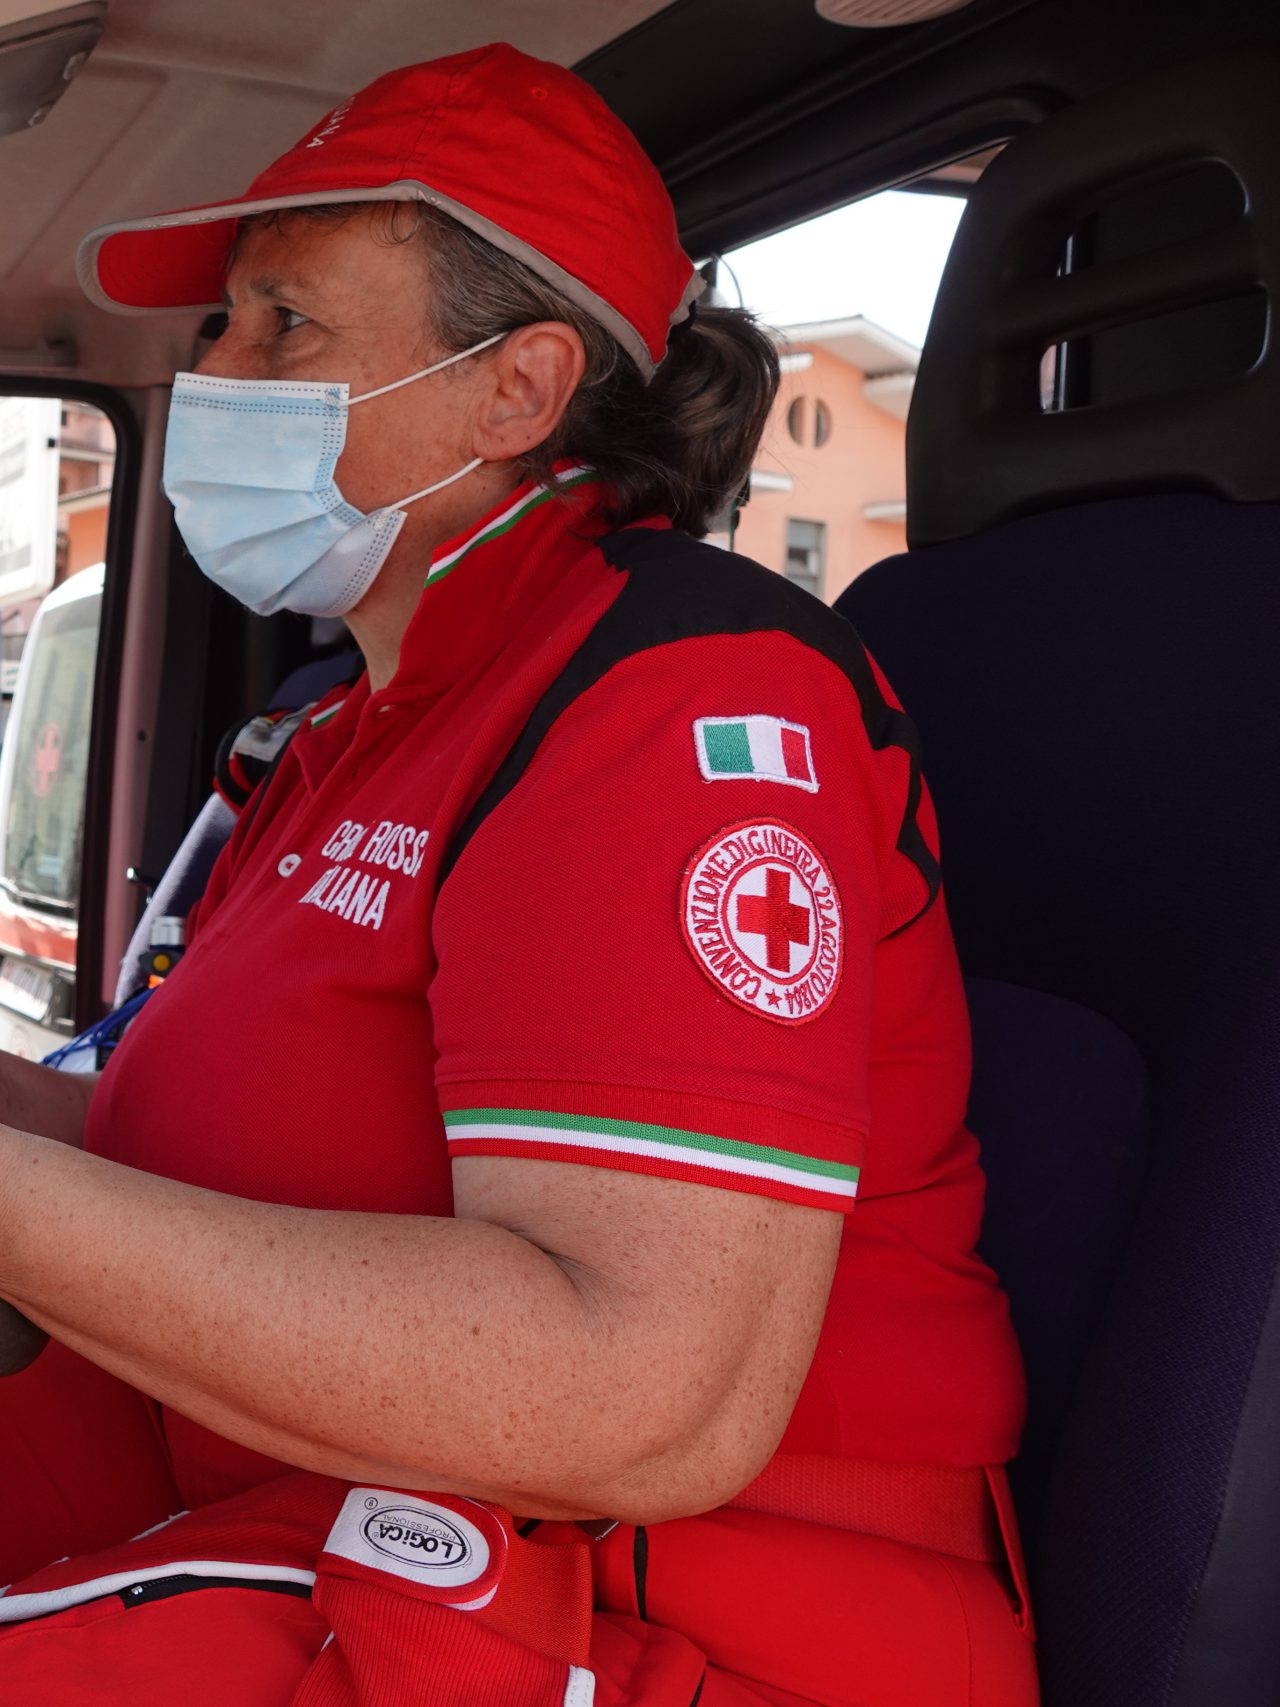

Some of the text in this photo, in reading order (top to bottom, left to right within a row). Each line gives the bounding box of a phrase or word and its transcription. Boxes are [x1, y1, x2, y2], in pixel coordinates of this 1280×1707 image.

[691, 851, 762, 1000] CONVENZIONE
[747, 829, 821, 888] GINEVRA
[809, 912, 837, 998] AGOSTO
[382, 1514, 457, 1542] PROFESSIONAL
